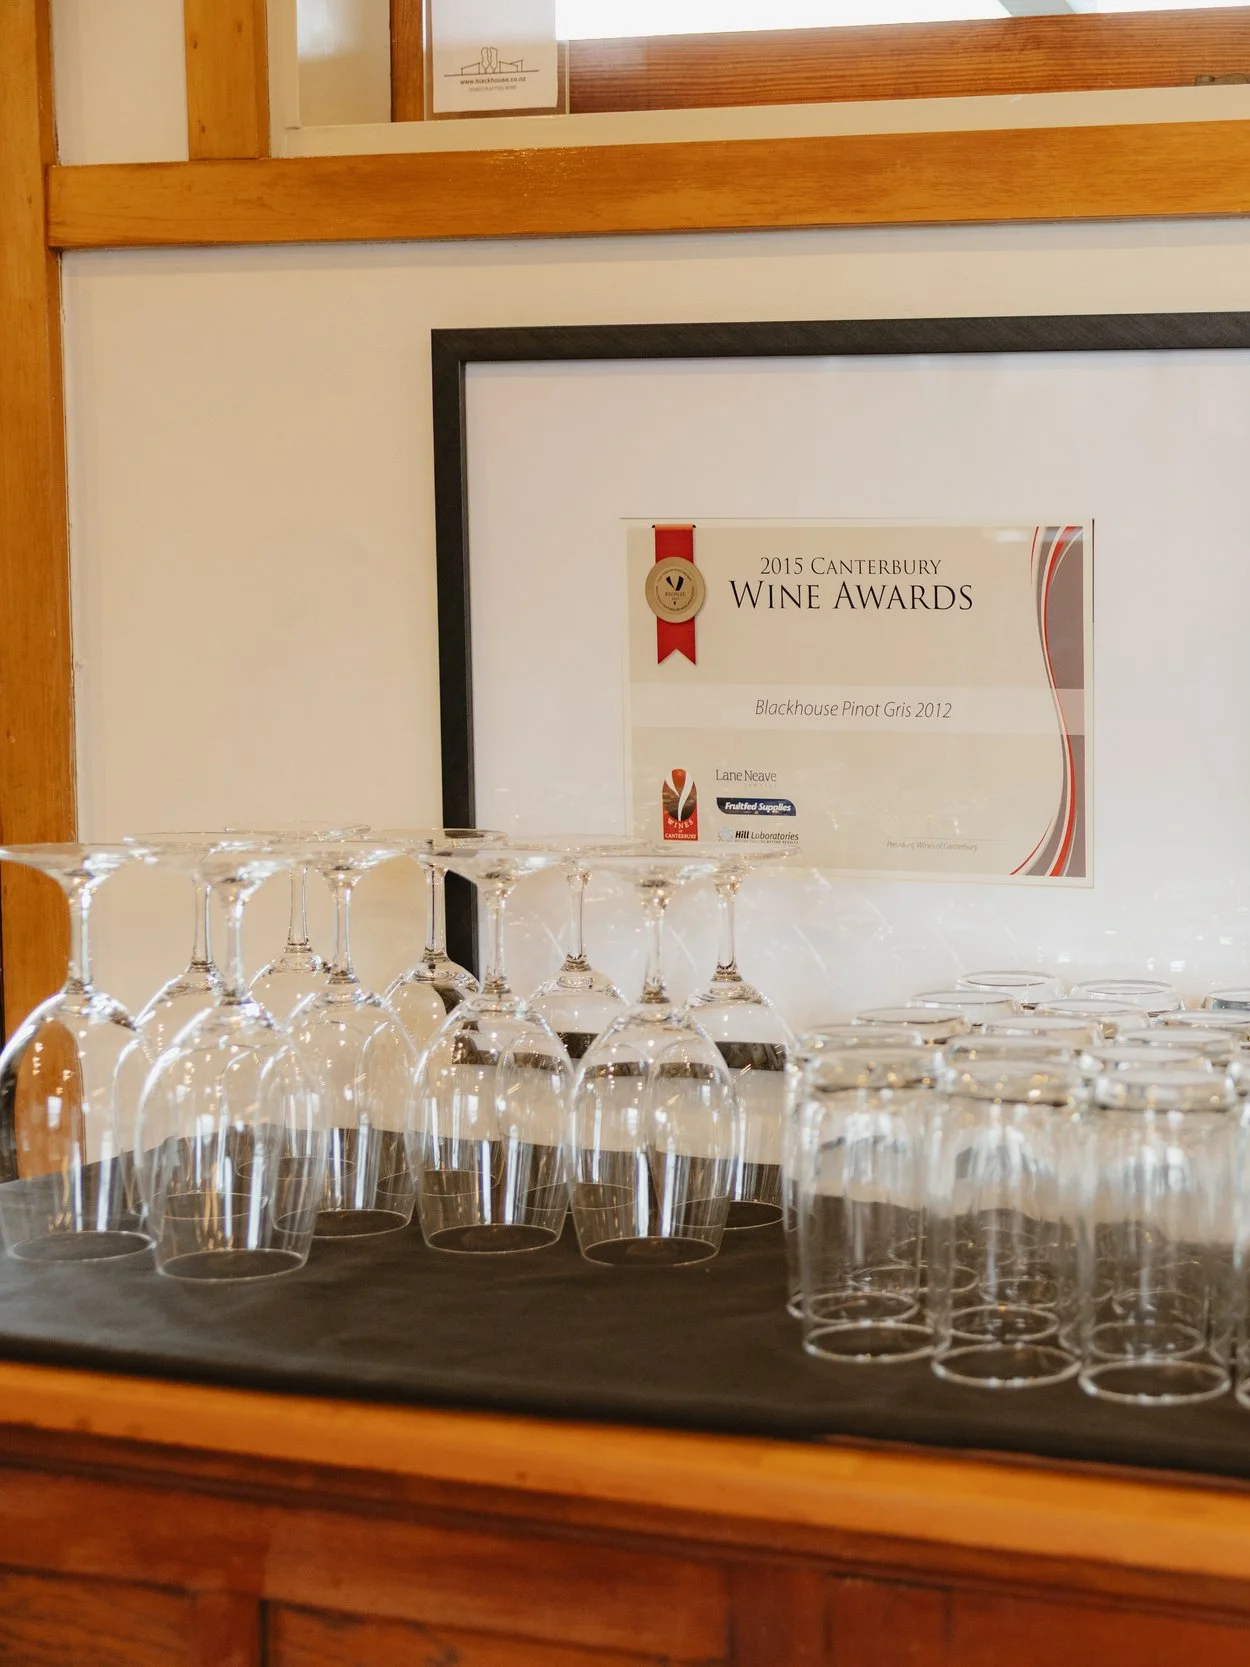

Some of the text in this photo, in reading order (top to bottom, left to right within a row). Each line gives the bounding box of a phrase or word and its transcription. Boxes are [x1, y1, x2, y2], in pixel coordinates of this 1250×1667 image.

[760, 556, 941, 575] 2015 CANTERBURY
[728, 580, 821, 610] WINE
[832, 581, 974, 611] AWARDS
[755, 698, 952, 719] Blackhouse Pinot Gris 2012
[716, 769, 777, 782] Lane Neave
[725, 801, 792, 813] Fruitfed Supplies
[667, 818, 694, 829] WINES
[735, 831, 799, 842] Hill Laboratories
